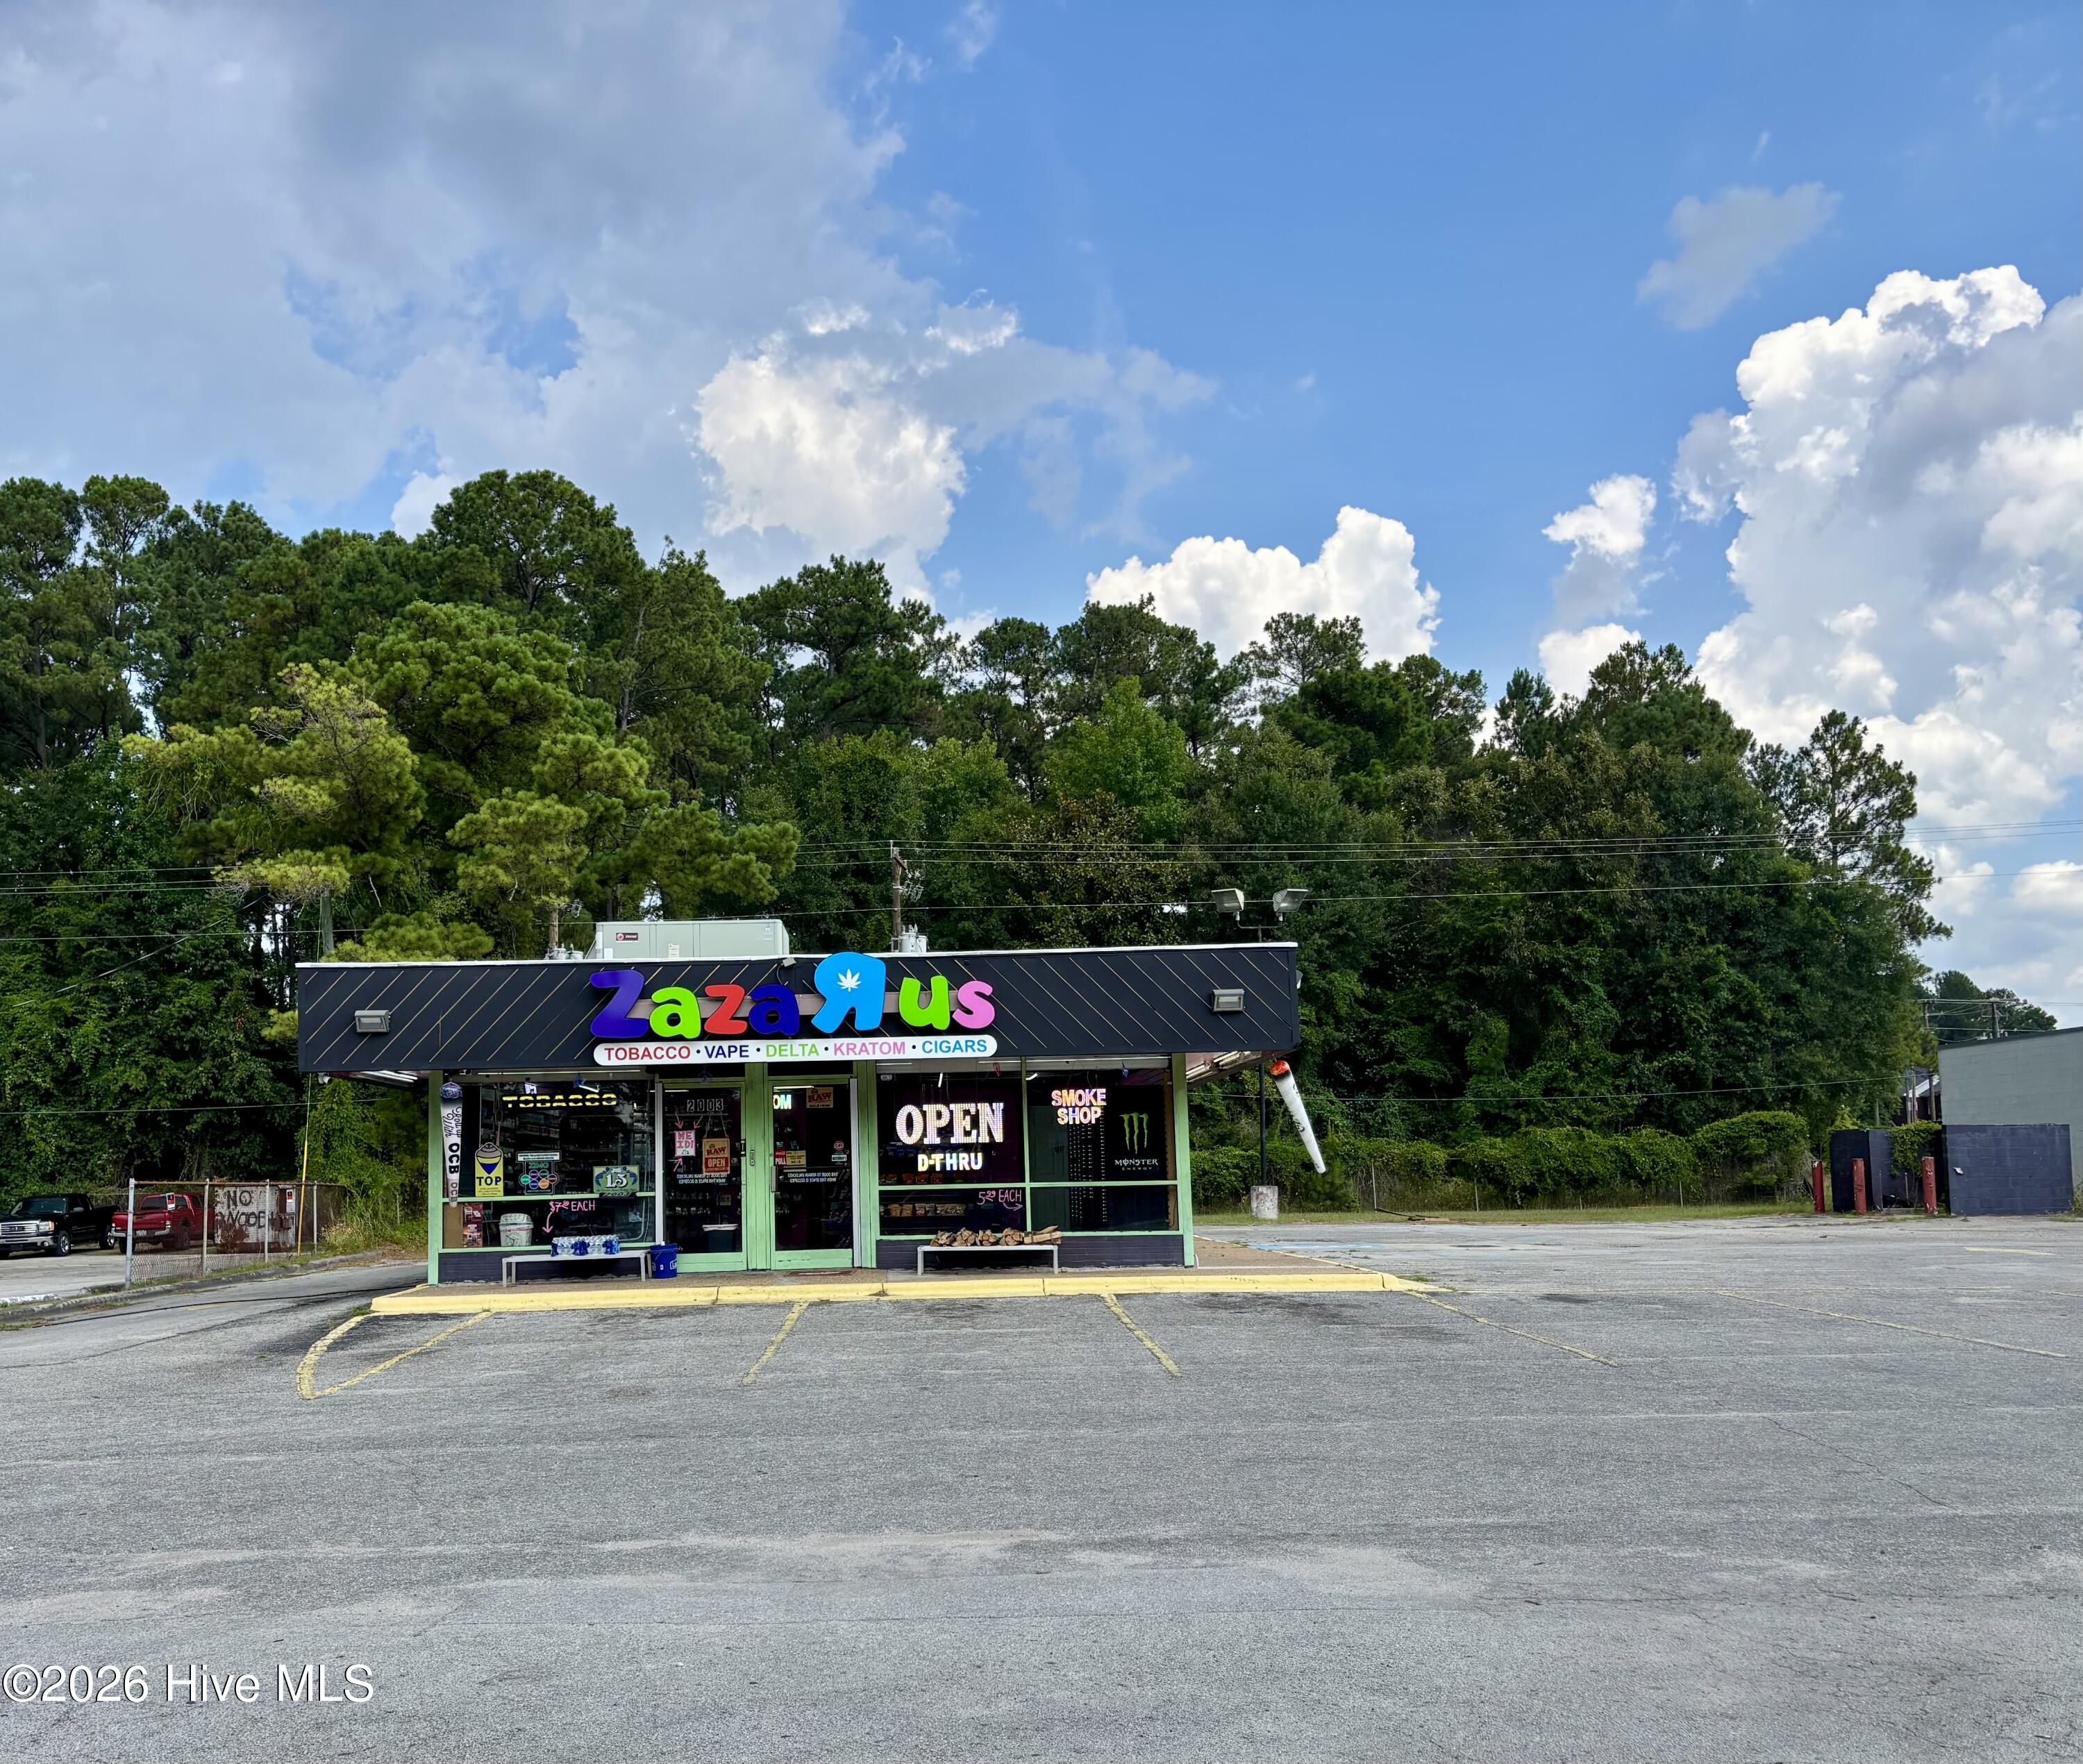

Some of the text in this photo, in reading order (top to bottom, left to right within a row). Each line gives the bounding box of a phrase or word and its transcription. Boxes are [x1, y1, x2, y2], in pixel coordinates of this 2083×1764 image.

[898, 975, 996, 1030] us
[604, 1040, 987, 1061] TOBACCO VAPE DELTA KRATOM CIGARS
[687, 1099, 723, 1111] 2003
[1051, 1089, 1107, 1106] SMOKE
[896, 1102, 1004, 1145] OPEN
[1057, 1108, 1102, 1125] SHOP
[448, 1143, 460, 1175] OCB
[706, 1146, 726, 1156] RAW
[708, 1158, 726, 1168] OPEN
[917, 1152, 982, 1172] D-THRU
[1114, 1158, 1159, 1166] MONSTER
[476, 1177, 502, 1186] TOP
[226, 1190, 252, 1209] NO
[998, 1188, 1022, 1202] EACH
[571, 1200, 595, 1211] EACH
